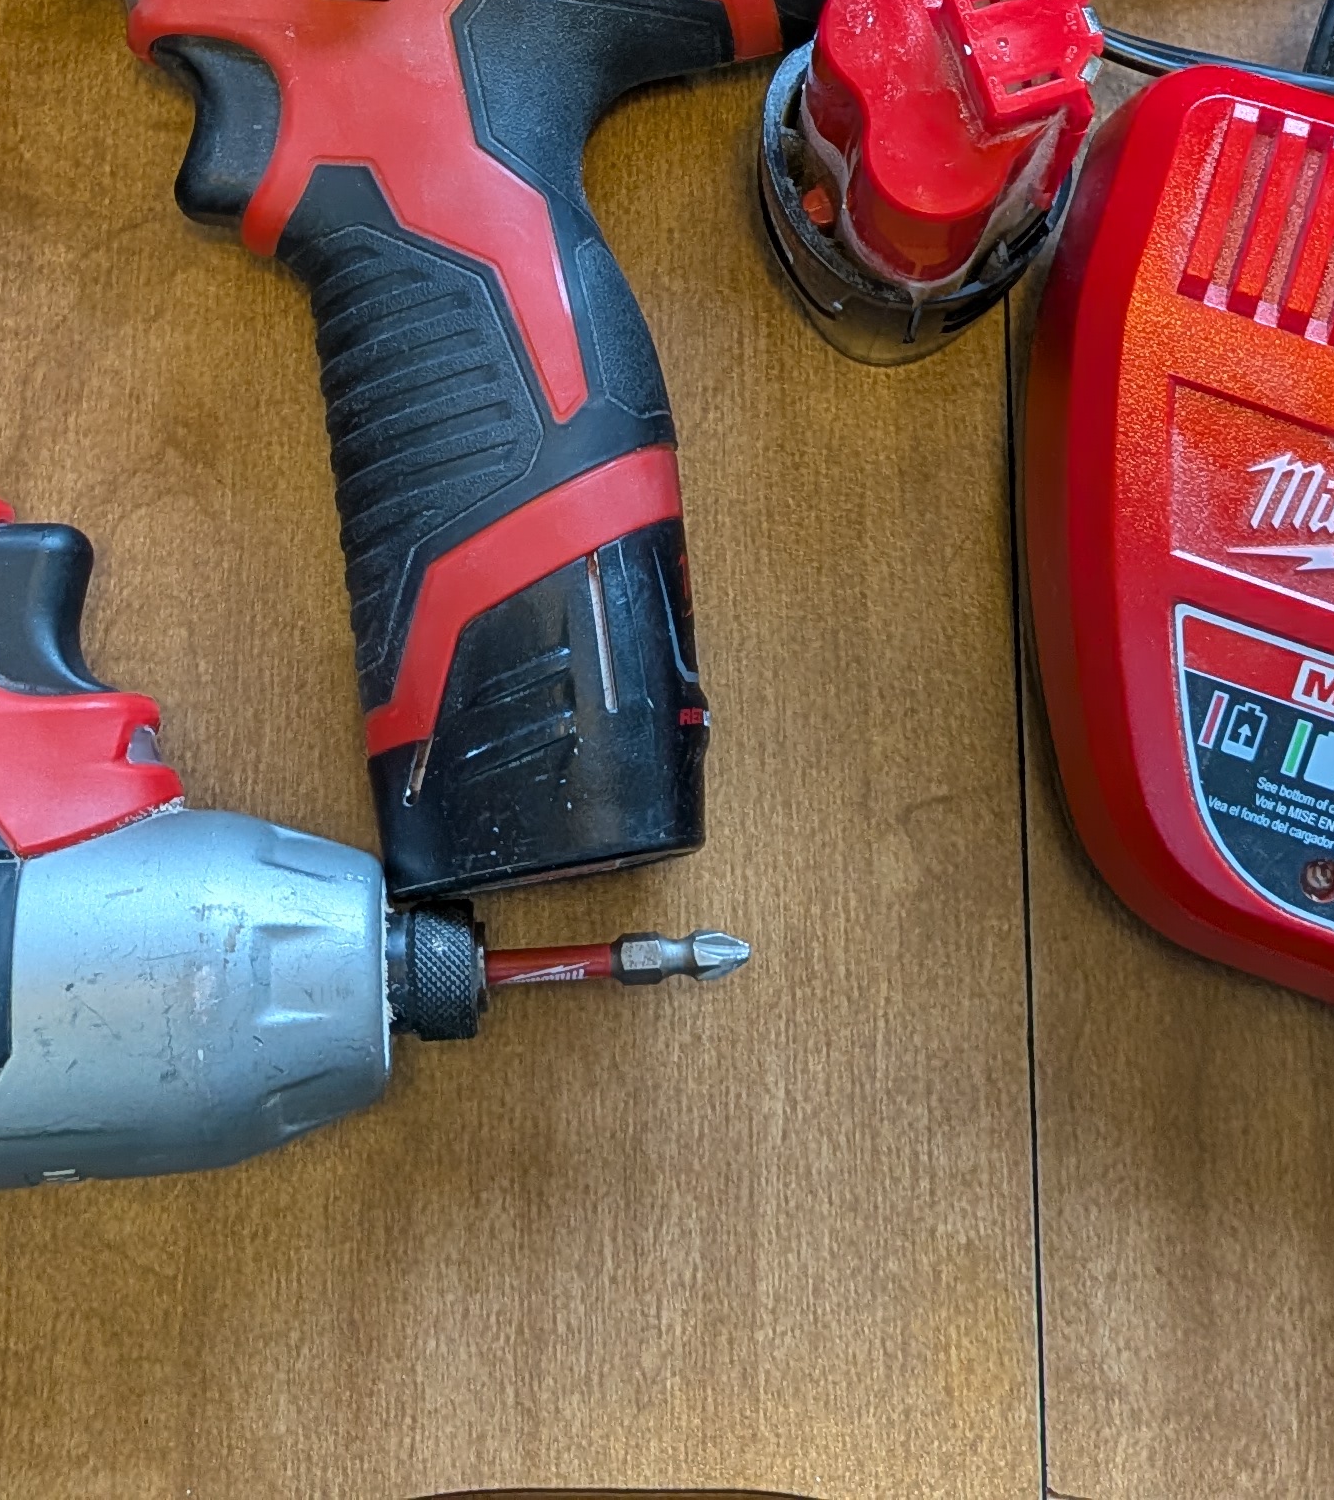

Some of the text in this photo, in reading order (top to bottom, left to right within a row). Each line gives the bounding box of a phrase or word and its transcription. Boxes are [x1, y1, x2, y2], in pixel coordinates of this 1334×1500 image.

[1255, 793, 1276, 810] Voir
[1276, 801, 1287, 815] le
[1288, 805, 1318, 827] MISE
[1256, 776, 1279, 794] See
[1279, 784, 1316, 807] bottom
[1316, 799, 1330, 812] of
[1208, 795, 1228, 813] Vea
[1228, 804, 1241, 817] el
[1240, 807, 1271, 828] fondo
[1271, 819, 1290, 835] del
